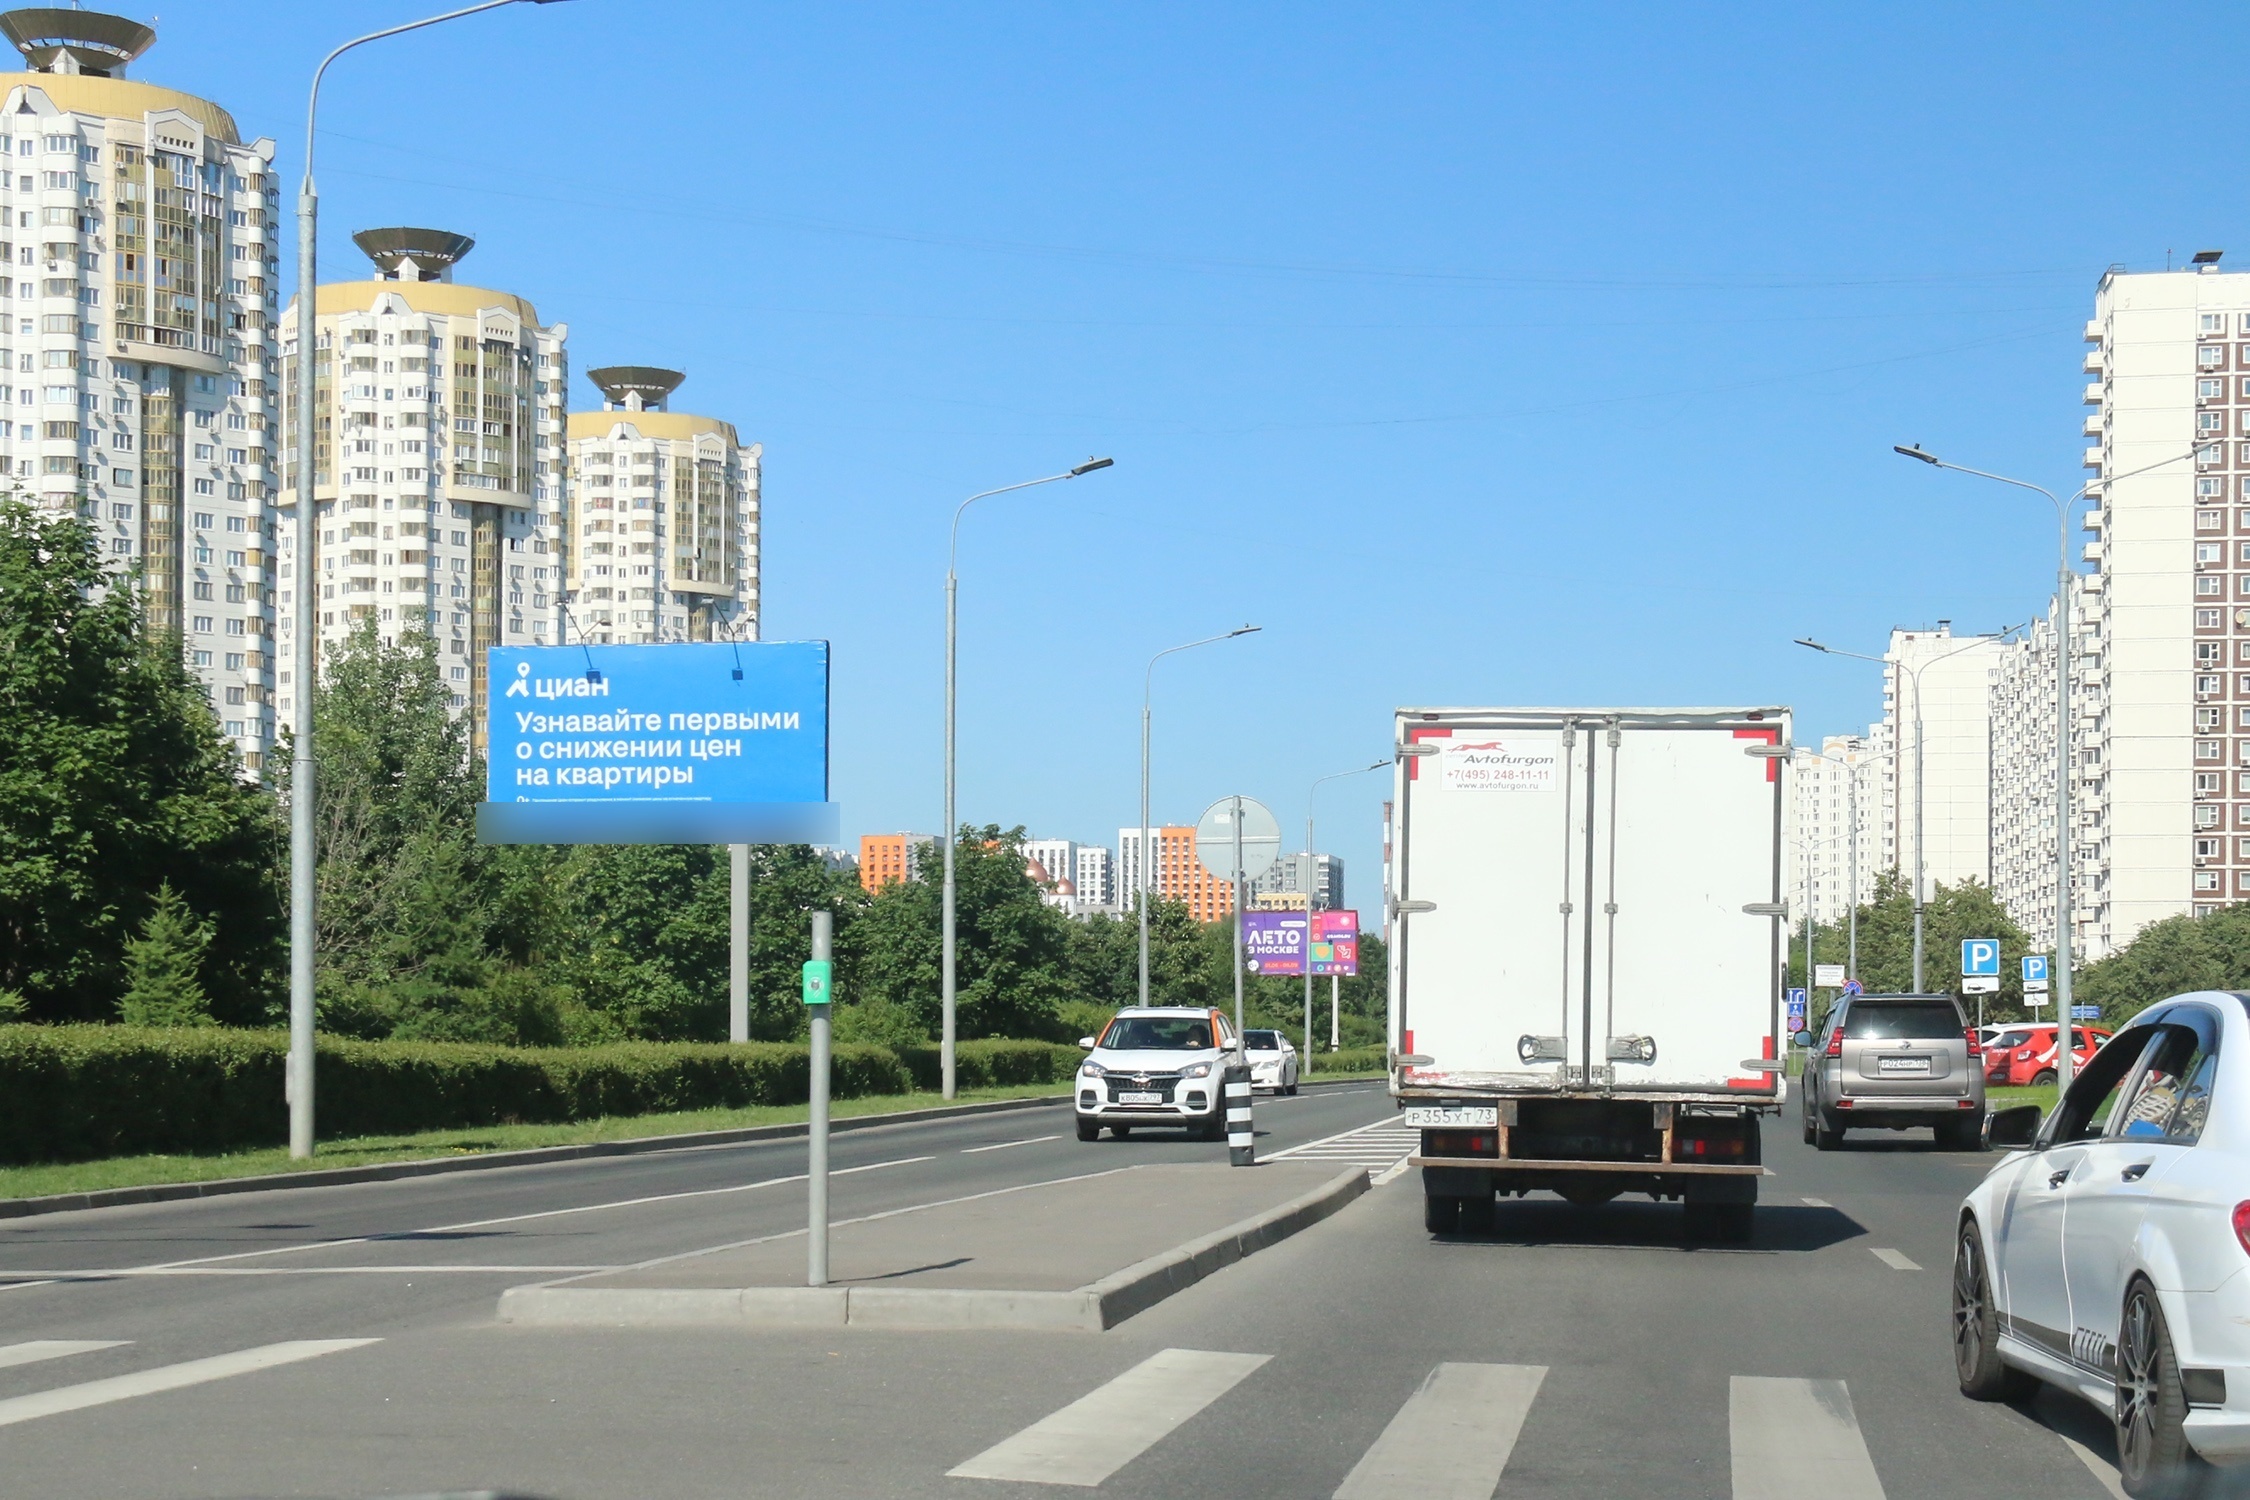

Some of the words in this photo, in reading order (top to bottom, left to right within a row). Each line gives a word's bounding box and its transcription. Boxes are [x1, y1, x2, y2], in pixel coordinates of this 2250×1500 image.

[535, 676, 609, 700] циан
[515, 708, 662, 734] Узнавайте
[669, 711, 800, 736] первыми
[516, 742, 533, 760] о
[538, 739, 682, 760] снижении
[689, 738, 742, 761] цен
[1463, 754, 1554, 766] Avtofurgon
[516, 768, 550, 786] на
[556, 765, 693, 790] квартиры
[1446, 769, 1490, 781] +7(495)
[1493, 769, 1549, 780] 248-11-11
[1456, 782, 1539, 790] www.avtofurgon.ru
[1247, 930, 1301, 945] ЛЕТО
[1256, 945, 1299, 954] МОСКВЕ
[1972, 943, 1993, 972] P
[2028, 959, 2043, 978] P
